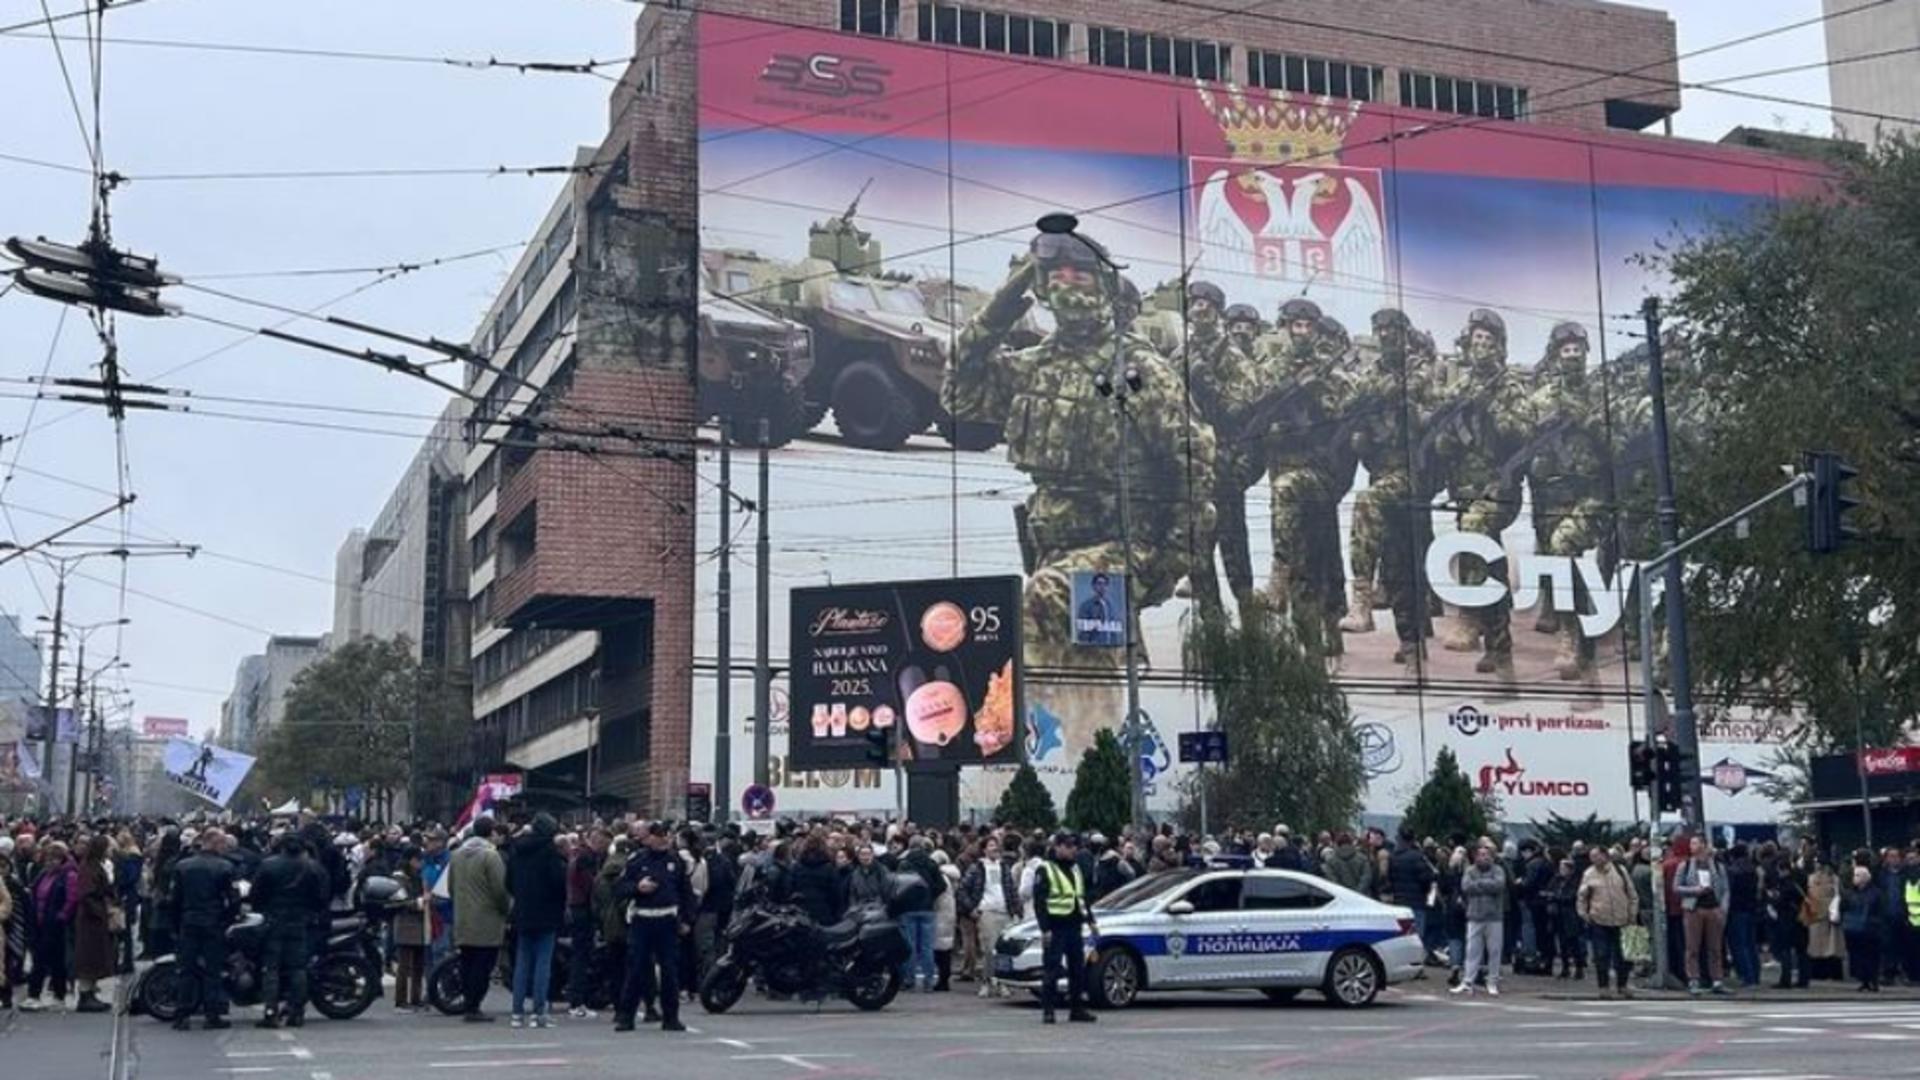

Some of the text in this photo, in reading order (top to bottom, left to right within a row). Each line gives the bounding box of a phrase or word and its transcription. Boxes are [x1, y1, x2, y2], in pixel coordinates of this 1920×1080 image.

[1425, 532, 1666, 638] Слу
[971, 606, 1000, 631] 95
[813, 659, 888, 675] BALKANA
[1504, 781, 1589, 796] YUMCO
[1197, 939, 1301, 953] ПОЛИЦИЈА
